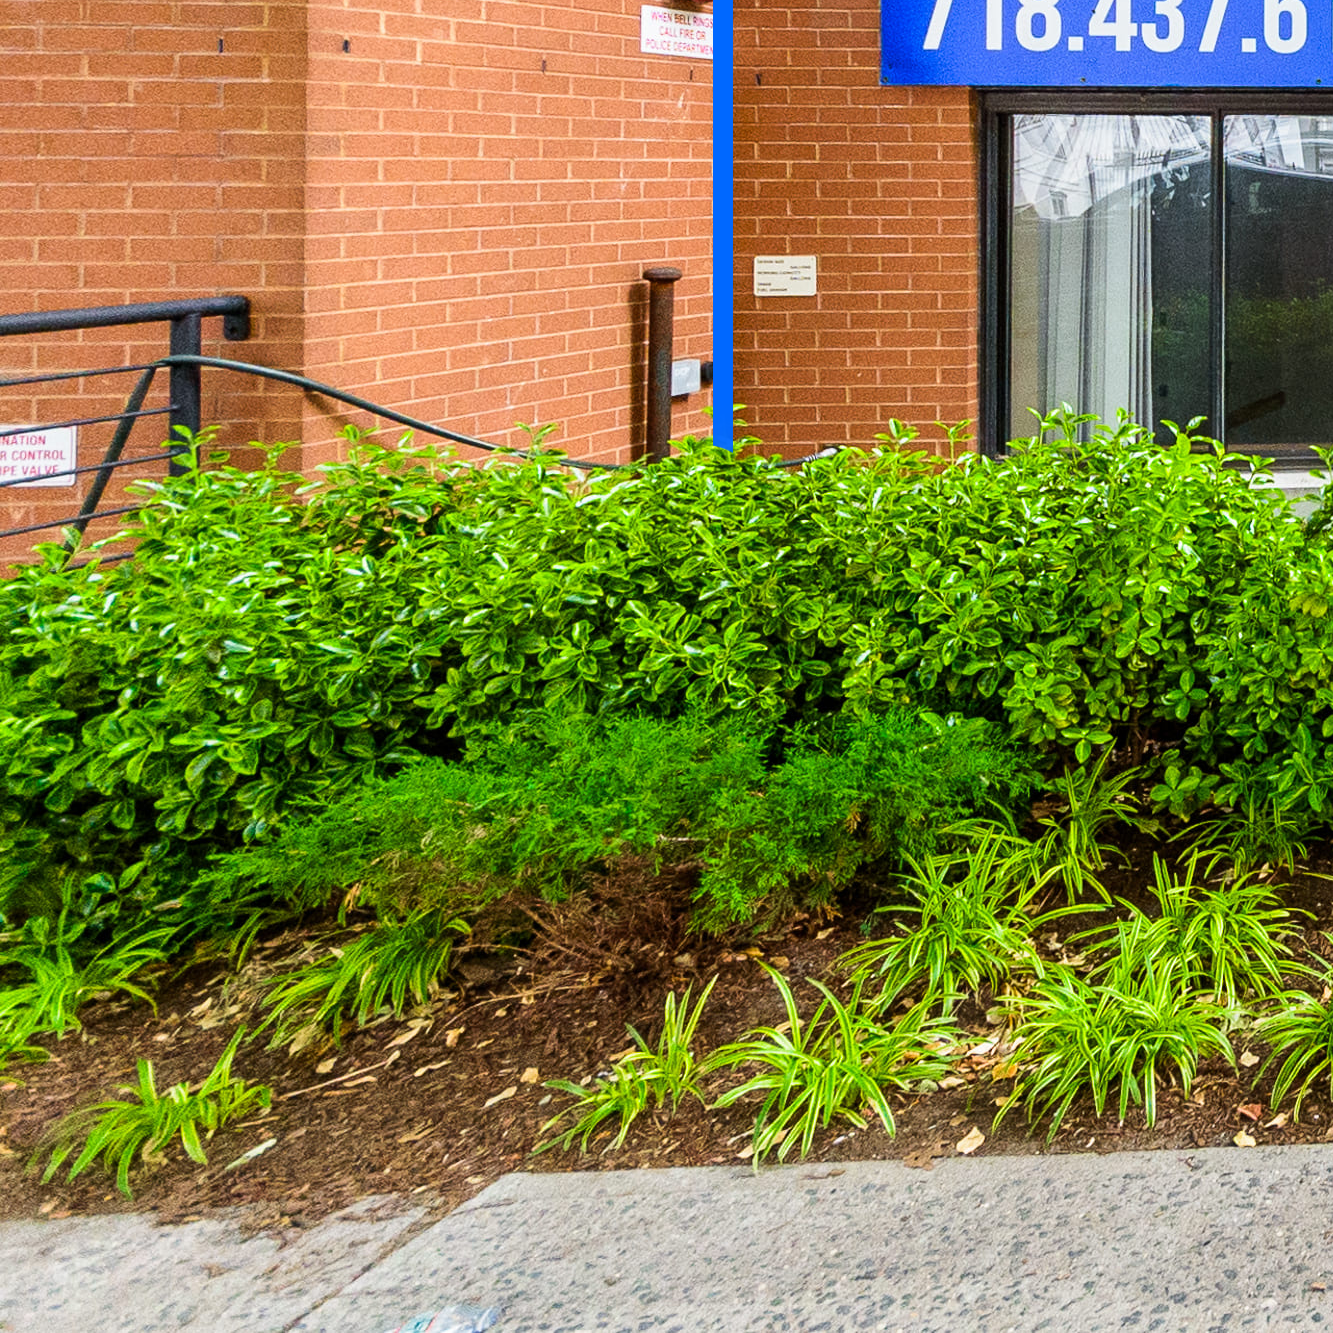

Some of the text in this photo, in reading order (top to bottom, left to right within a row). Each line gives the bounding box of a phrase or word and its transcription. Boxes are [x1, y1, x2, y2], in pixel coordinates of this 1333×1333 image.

[651, 11, 673, 23] WHEN
[674, 13, 692, 26] BELL
[659, 26, 678, 38] CALL
[680, 28, 695, 40] FIRE
[646, 38, 713, 55] POLICE DEPARTMEN
[11, 449, 67, 461] CONTROL
[22, 464, 59, 477] VALVE
